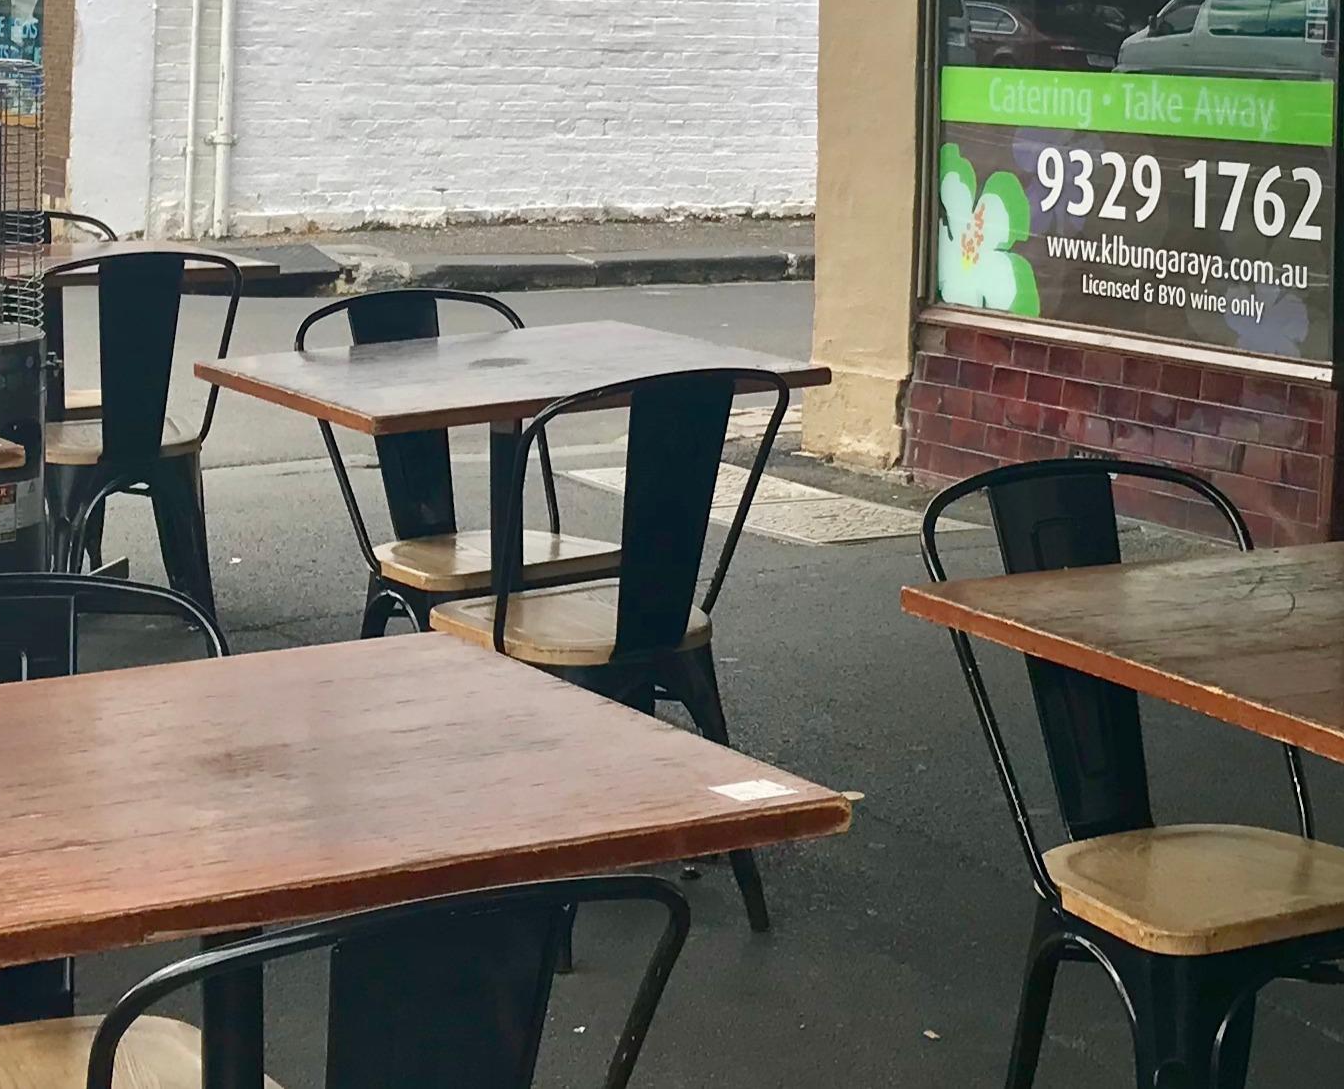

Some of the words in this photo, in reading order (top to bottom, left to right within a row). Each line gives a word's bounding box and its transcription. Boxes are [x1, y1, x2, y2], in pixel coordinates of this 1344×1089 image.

[989, 77, 1093, 128] Catering
[1121, 81, 1184, 124] Take
[1192, 87, 1277, 137] Away
[1035, 146, 1163, 224] 9329
[1184, 158, 1324, 242] 1762
[1046, 234, 1309, 290] www.klbungaraya.com.au
[1081, 273, 1140, 302] Licensed
[1143, 282, 1154, 303] &
[1158, 283, 1186, 308] BYO
[1189, 288, 1227, 314] wine
[1231, 294, 1265, 324] only
